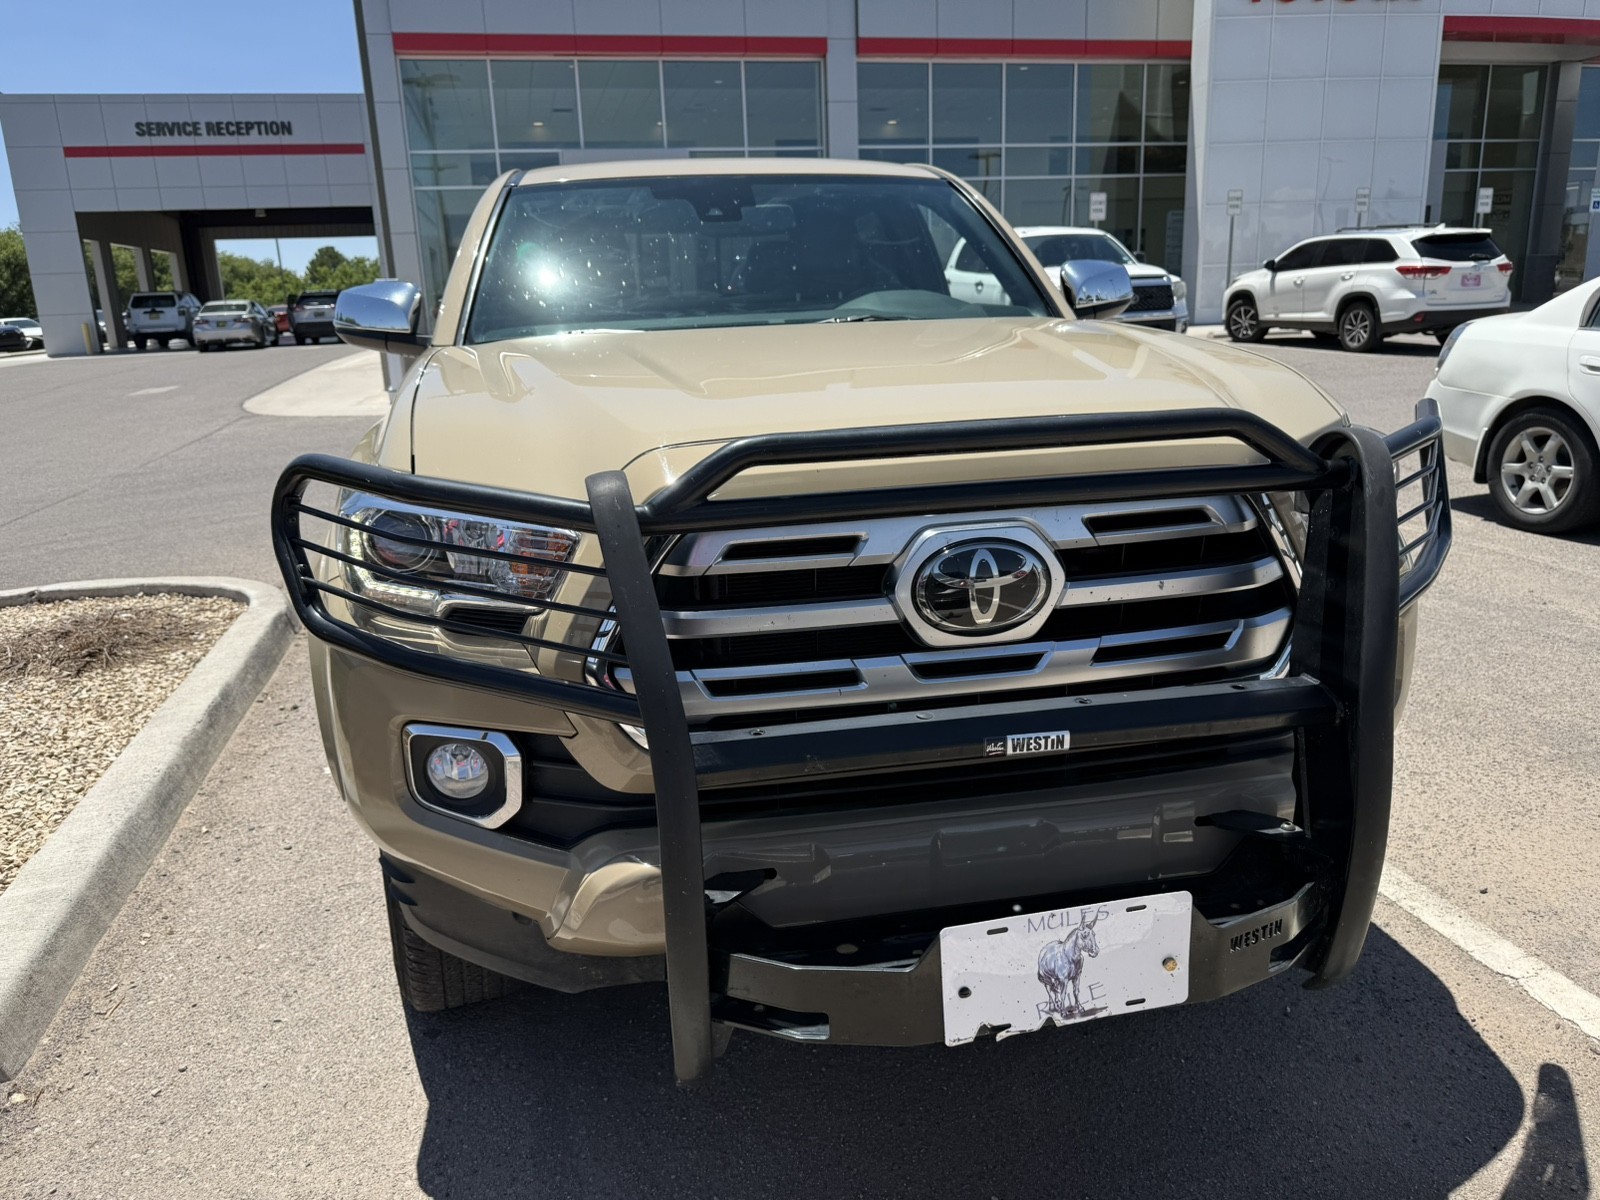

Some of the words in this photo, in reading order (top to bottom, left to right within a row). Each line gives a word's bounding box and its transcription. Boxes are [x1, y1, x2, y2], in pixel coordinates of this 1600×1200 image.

[135, 121, 202, 137] SERVICE
[205, 120, 292, 136] RECEPTION
[1028, 904, 1109, 933] MULES
